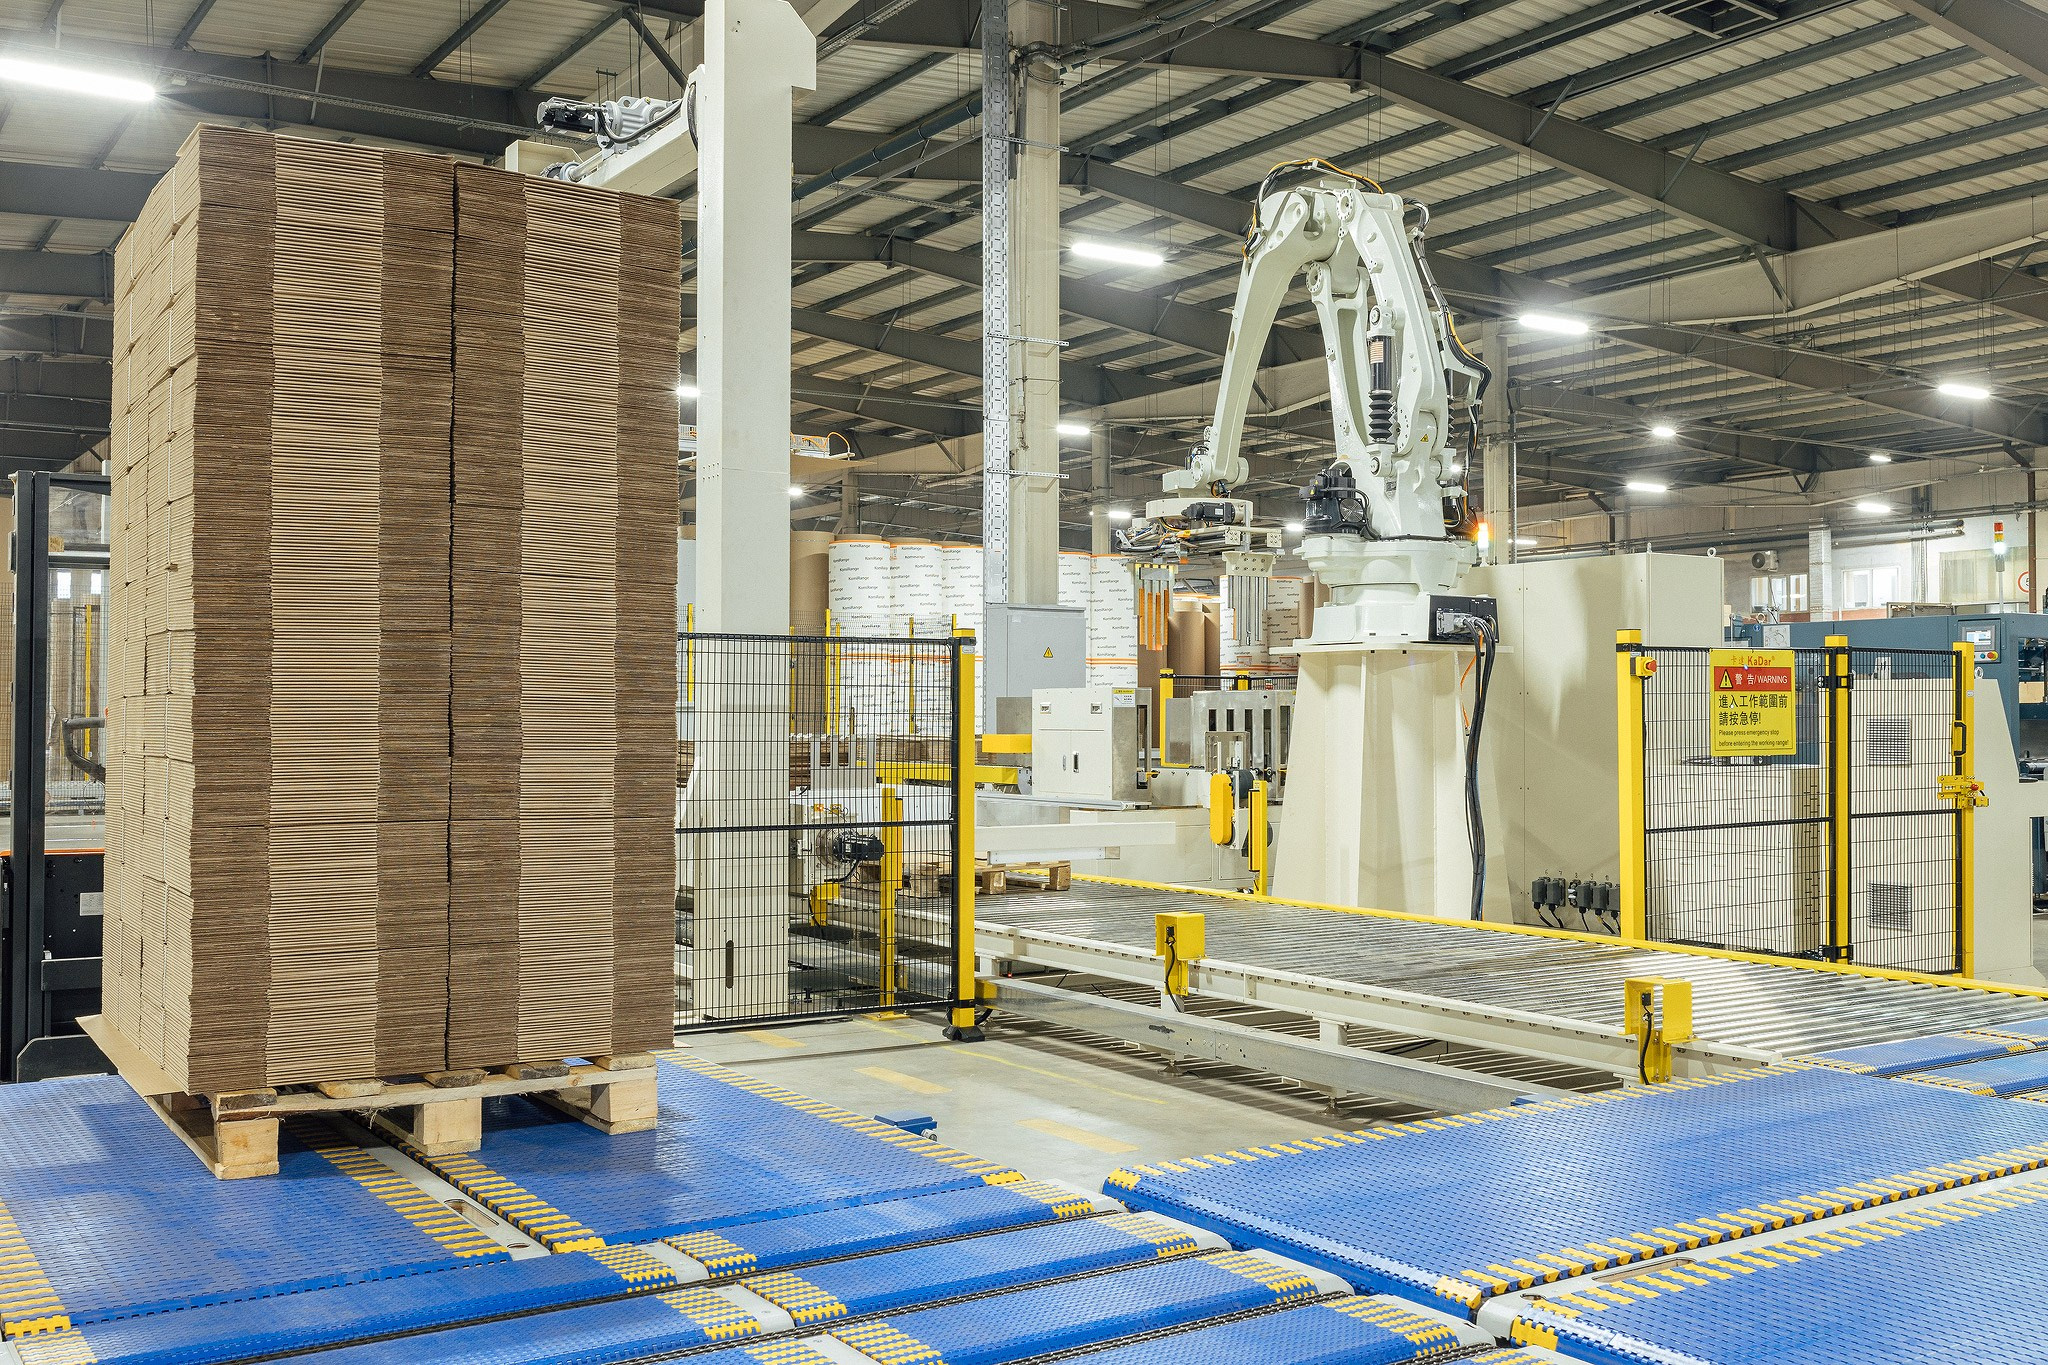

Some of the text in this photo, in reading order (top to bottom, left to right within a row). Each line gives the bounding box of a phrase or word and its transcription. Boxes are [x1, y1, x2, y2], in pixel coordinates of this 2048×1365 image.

[1719, 694, 1788, 708] 進入工作範圍前
[1719, 712, 1761, 726] 請按急停!
